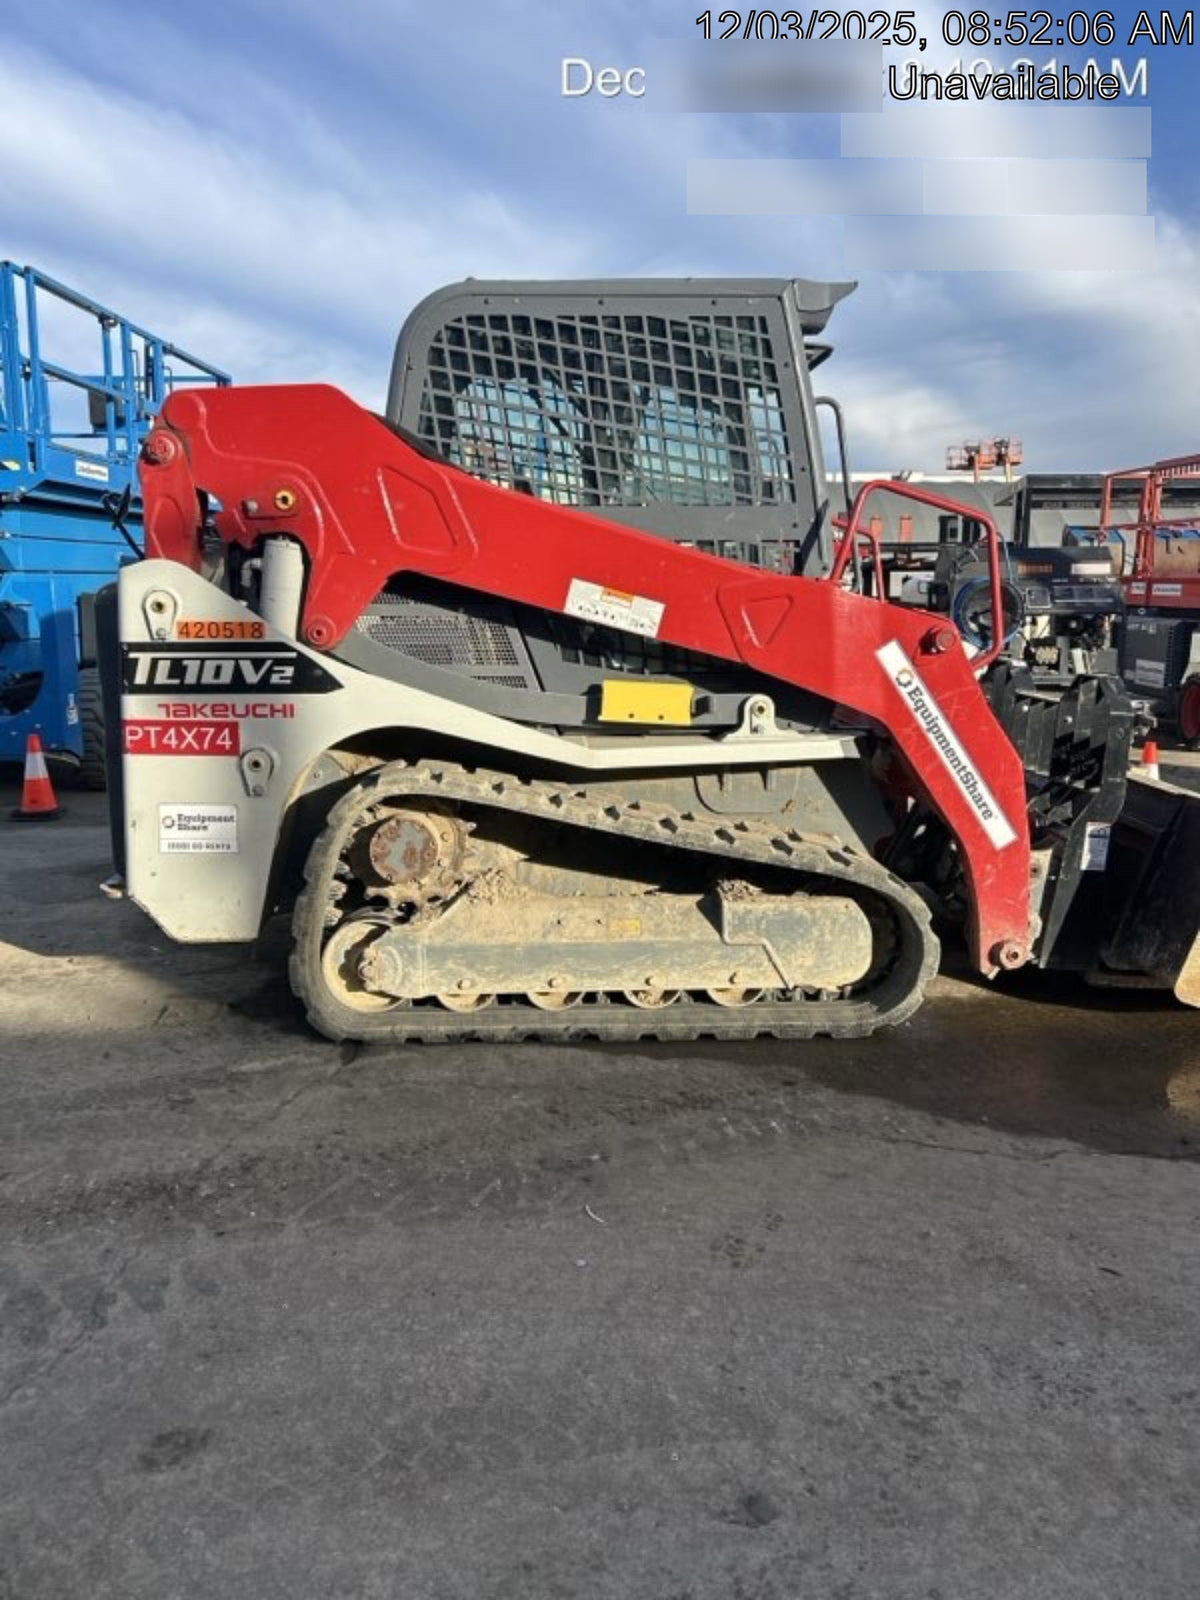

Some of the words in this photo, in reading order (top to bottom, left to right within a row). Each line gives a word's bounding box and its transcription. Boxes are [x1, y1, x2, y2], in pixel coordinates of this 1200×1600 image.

[178, 621, 264, 639] 420518
[125, 727, 233, 750] PT4X74
[907, 686, 994, 821] EquipmentShare
[176, 813, 235, 825] Equipment
